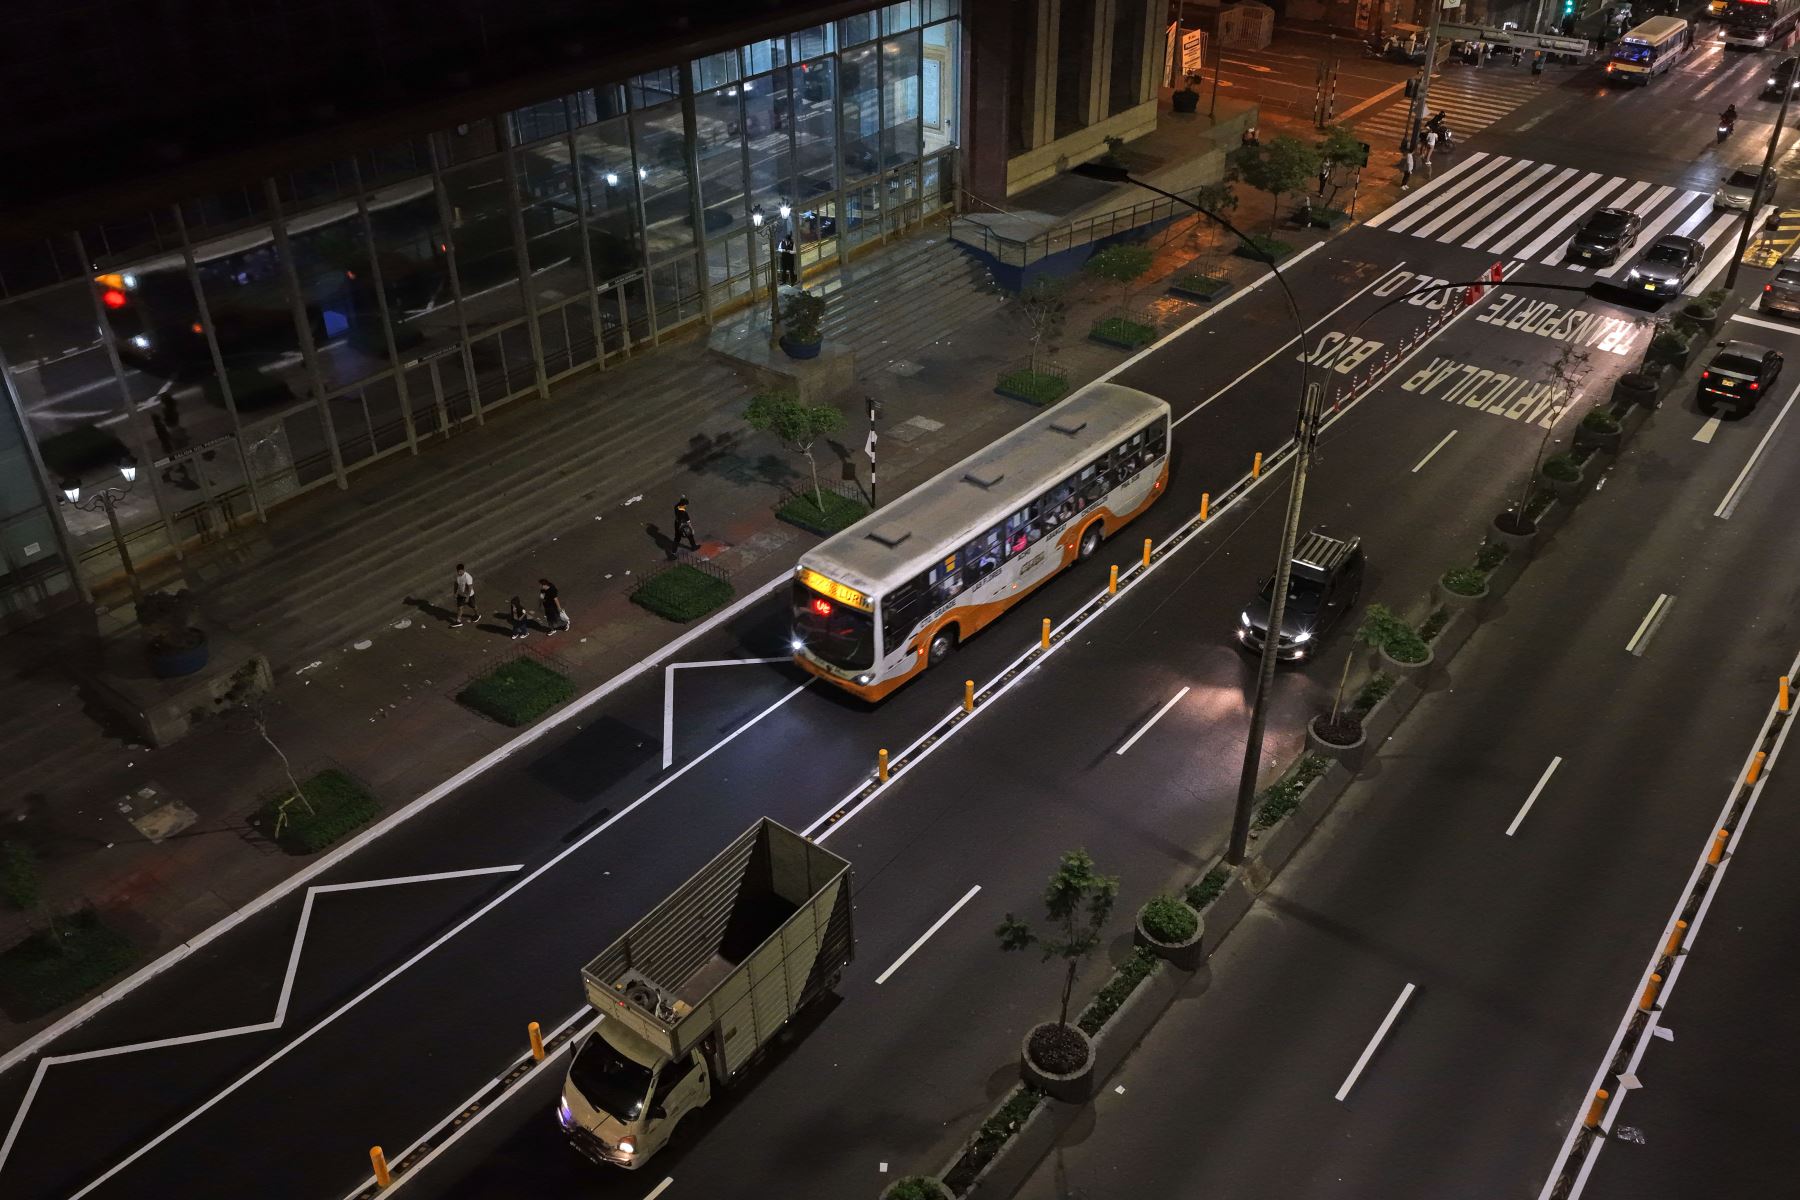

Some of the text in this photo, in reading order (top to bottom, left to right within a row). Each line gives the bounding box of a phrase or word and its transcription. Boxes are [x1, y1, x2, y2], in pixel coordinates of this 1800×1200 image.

[1373, 271, 1466, 310] SOLO
[1476, 293, 1643, 356] TRANSPORTE
[1296, 332, 1385, 374] BUS
[1401, 357, 1584, 430] PARTICULAR
